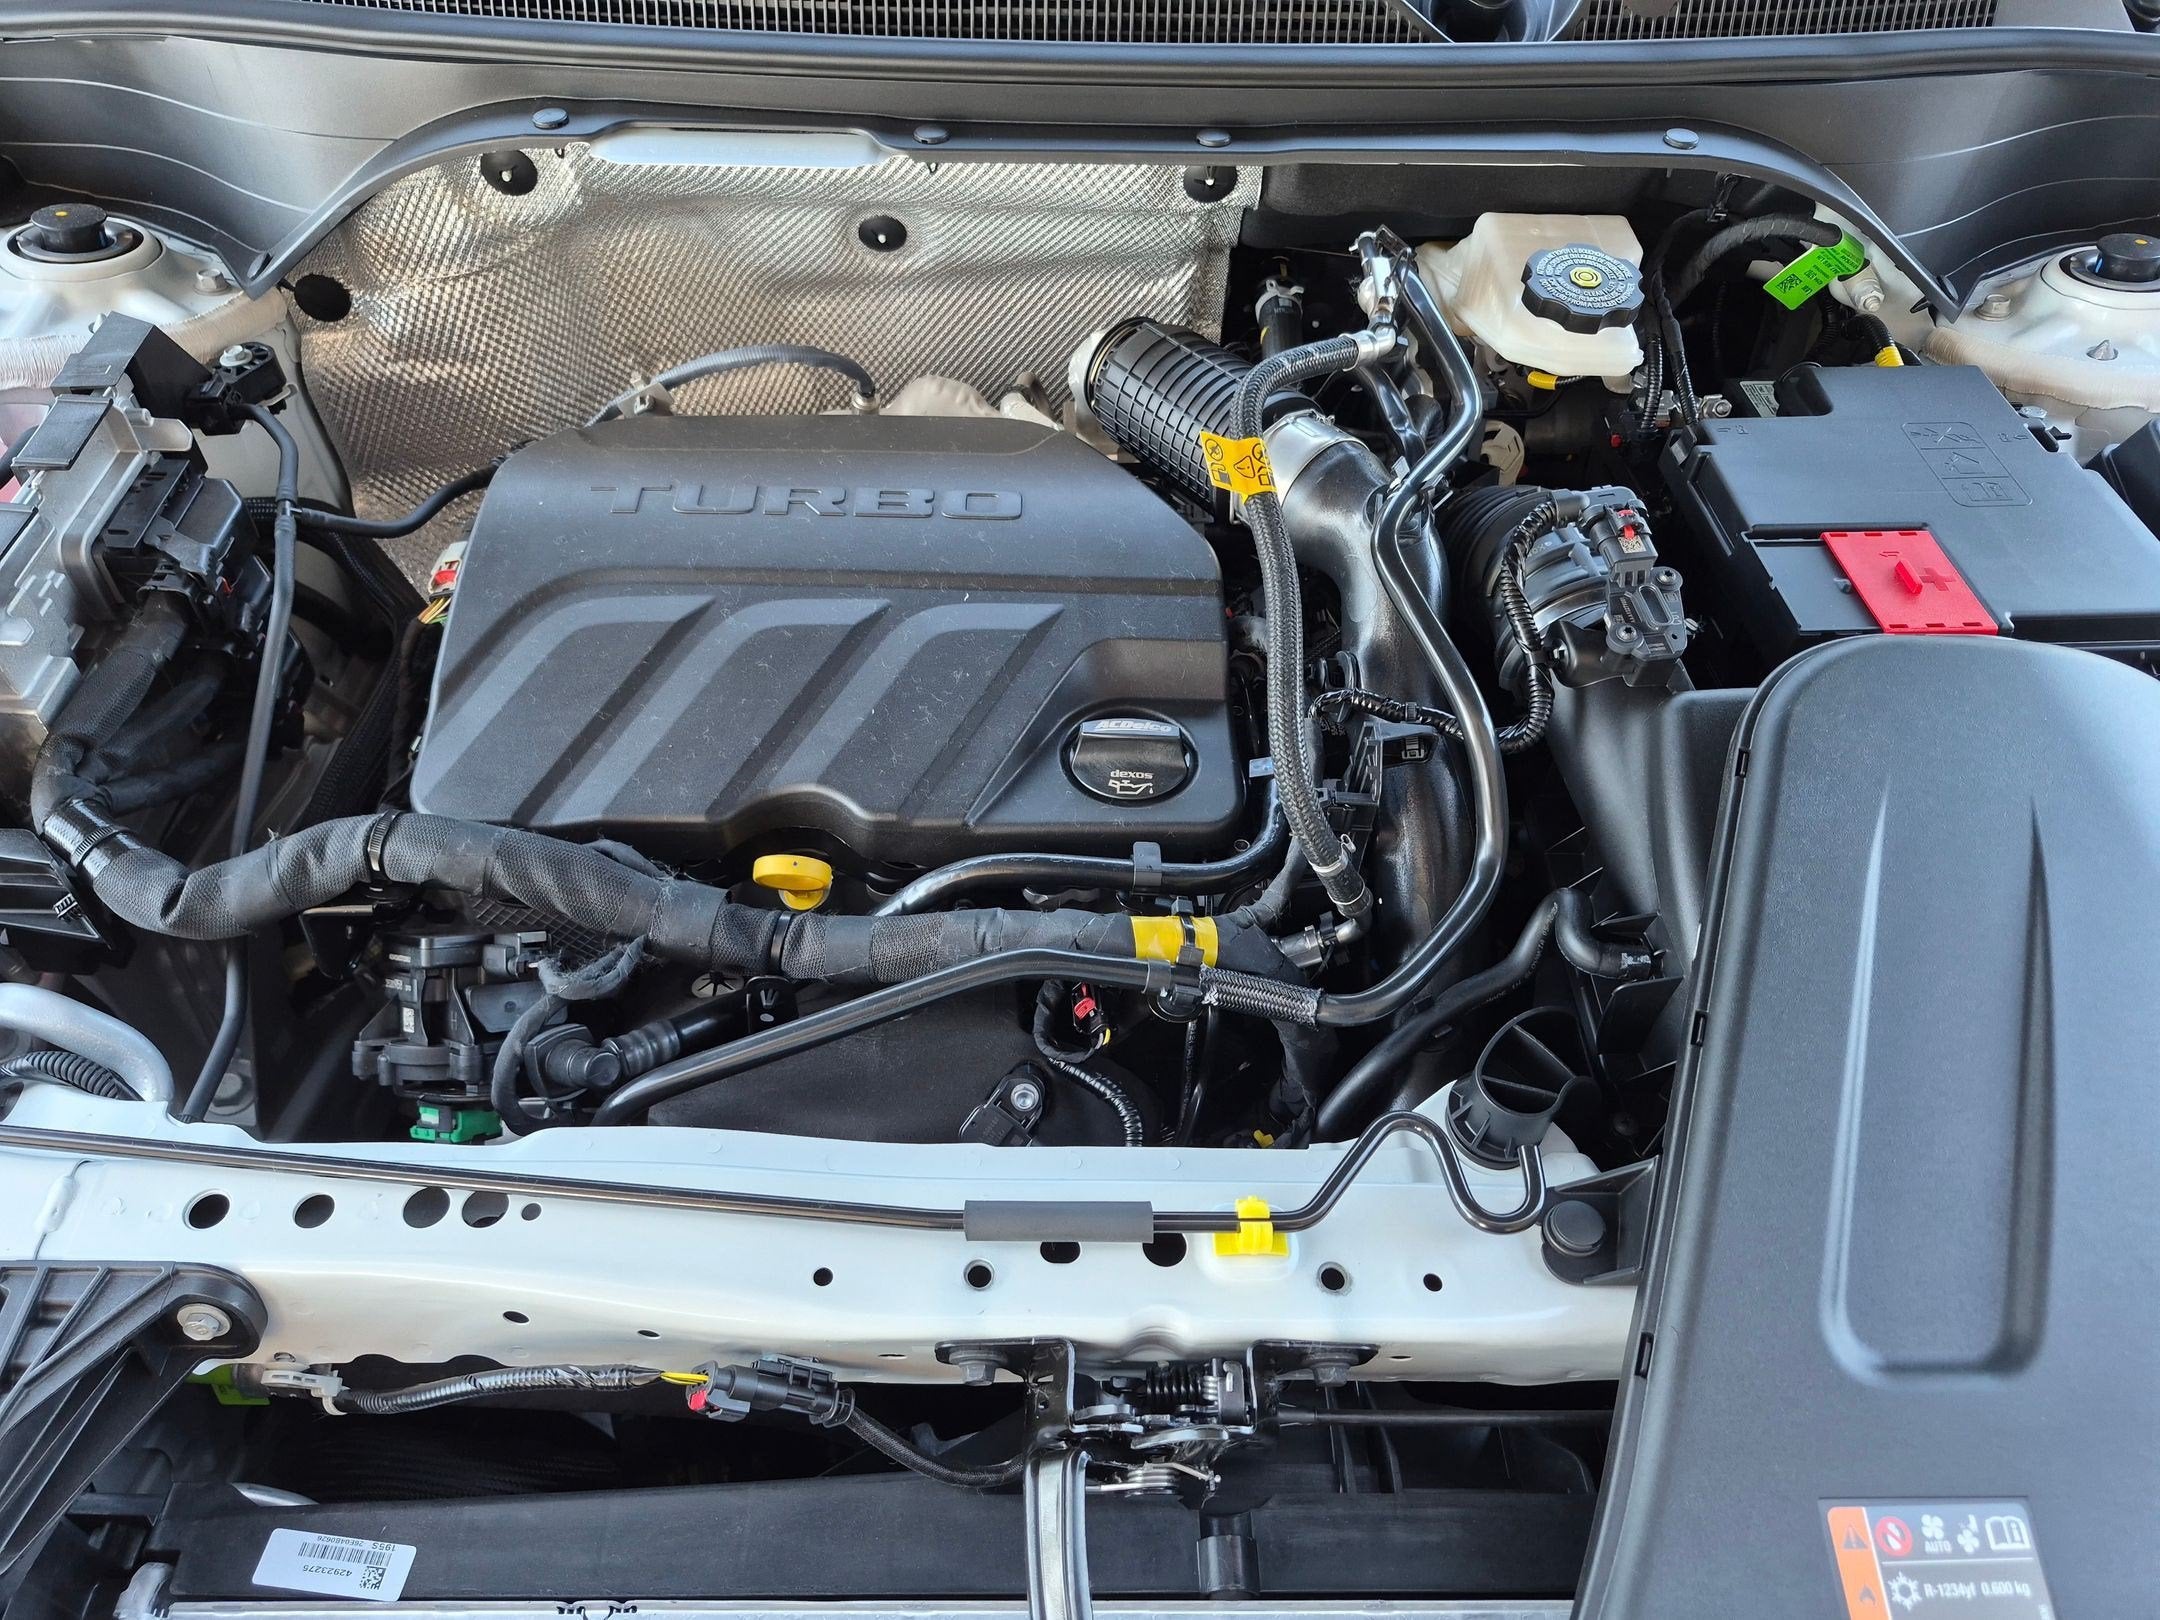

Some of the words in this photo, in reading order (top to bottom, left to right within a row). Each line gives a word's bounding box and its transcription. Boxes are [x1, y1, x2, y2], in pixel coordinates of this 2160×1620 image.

[1566, 297, 1586, 306] FROM
[590, 484, 1023, 520] TURBO
[1095, 719, 1172, 732] ACDelco
[1110, 770, 1154, 780] dexos
[372, 1542, 397, 1552] 195S
[1925, 1540, 1952, 1554] AUTO
[302, 1564, 353, 1578] 42923275
[1980, 1581, 2012, 1596] 0.600
[2014, 1580, 2031, 1597] kg
